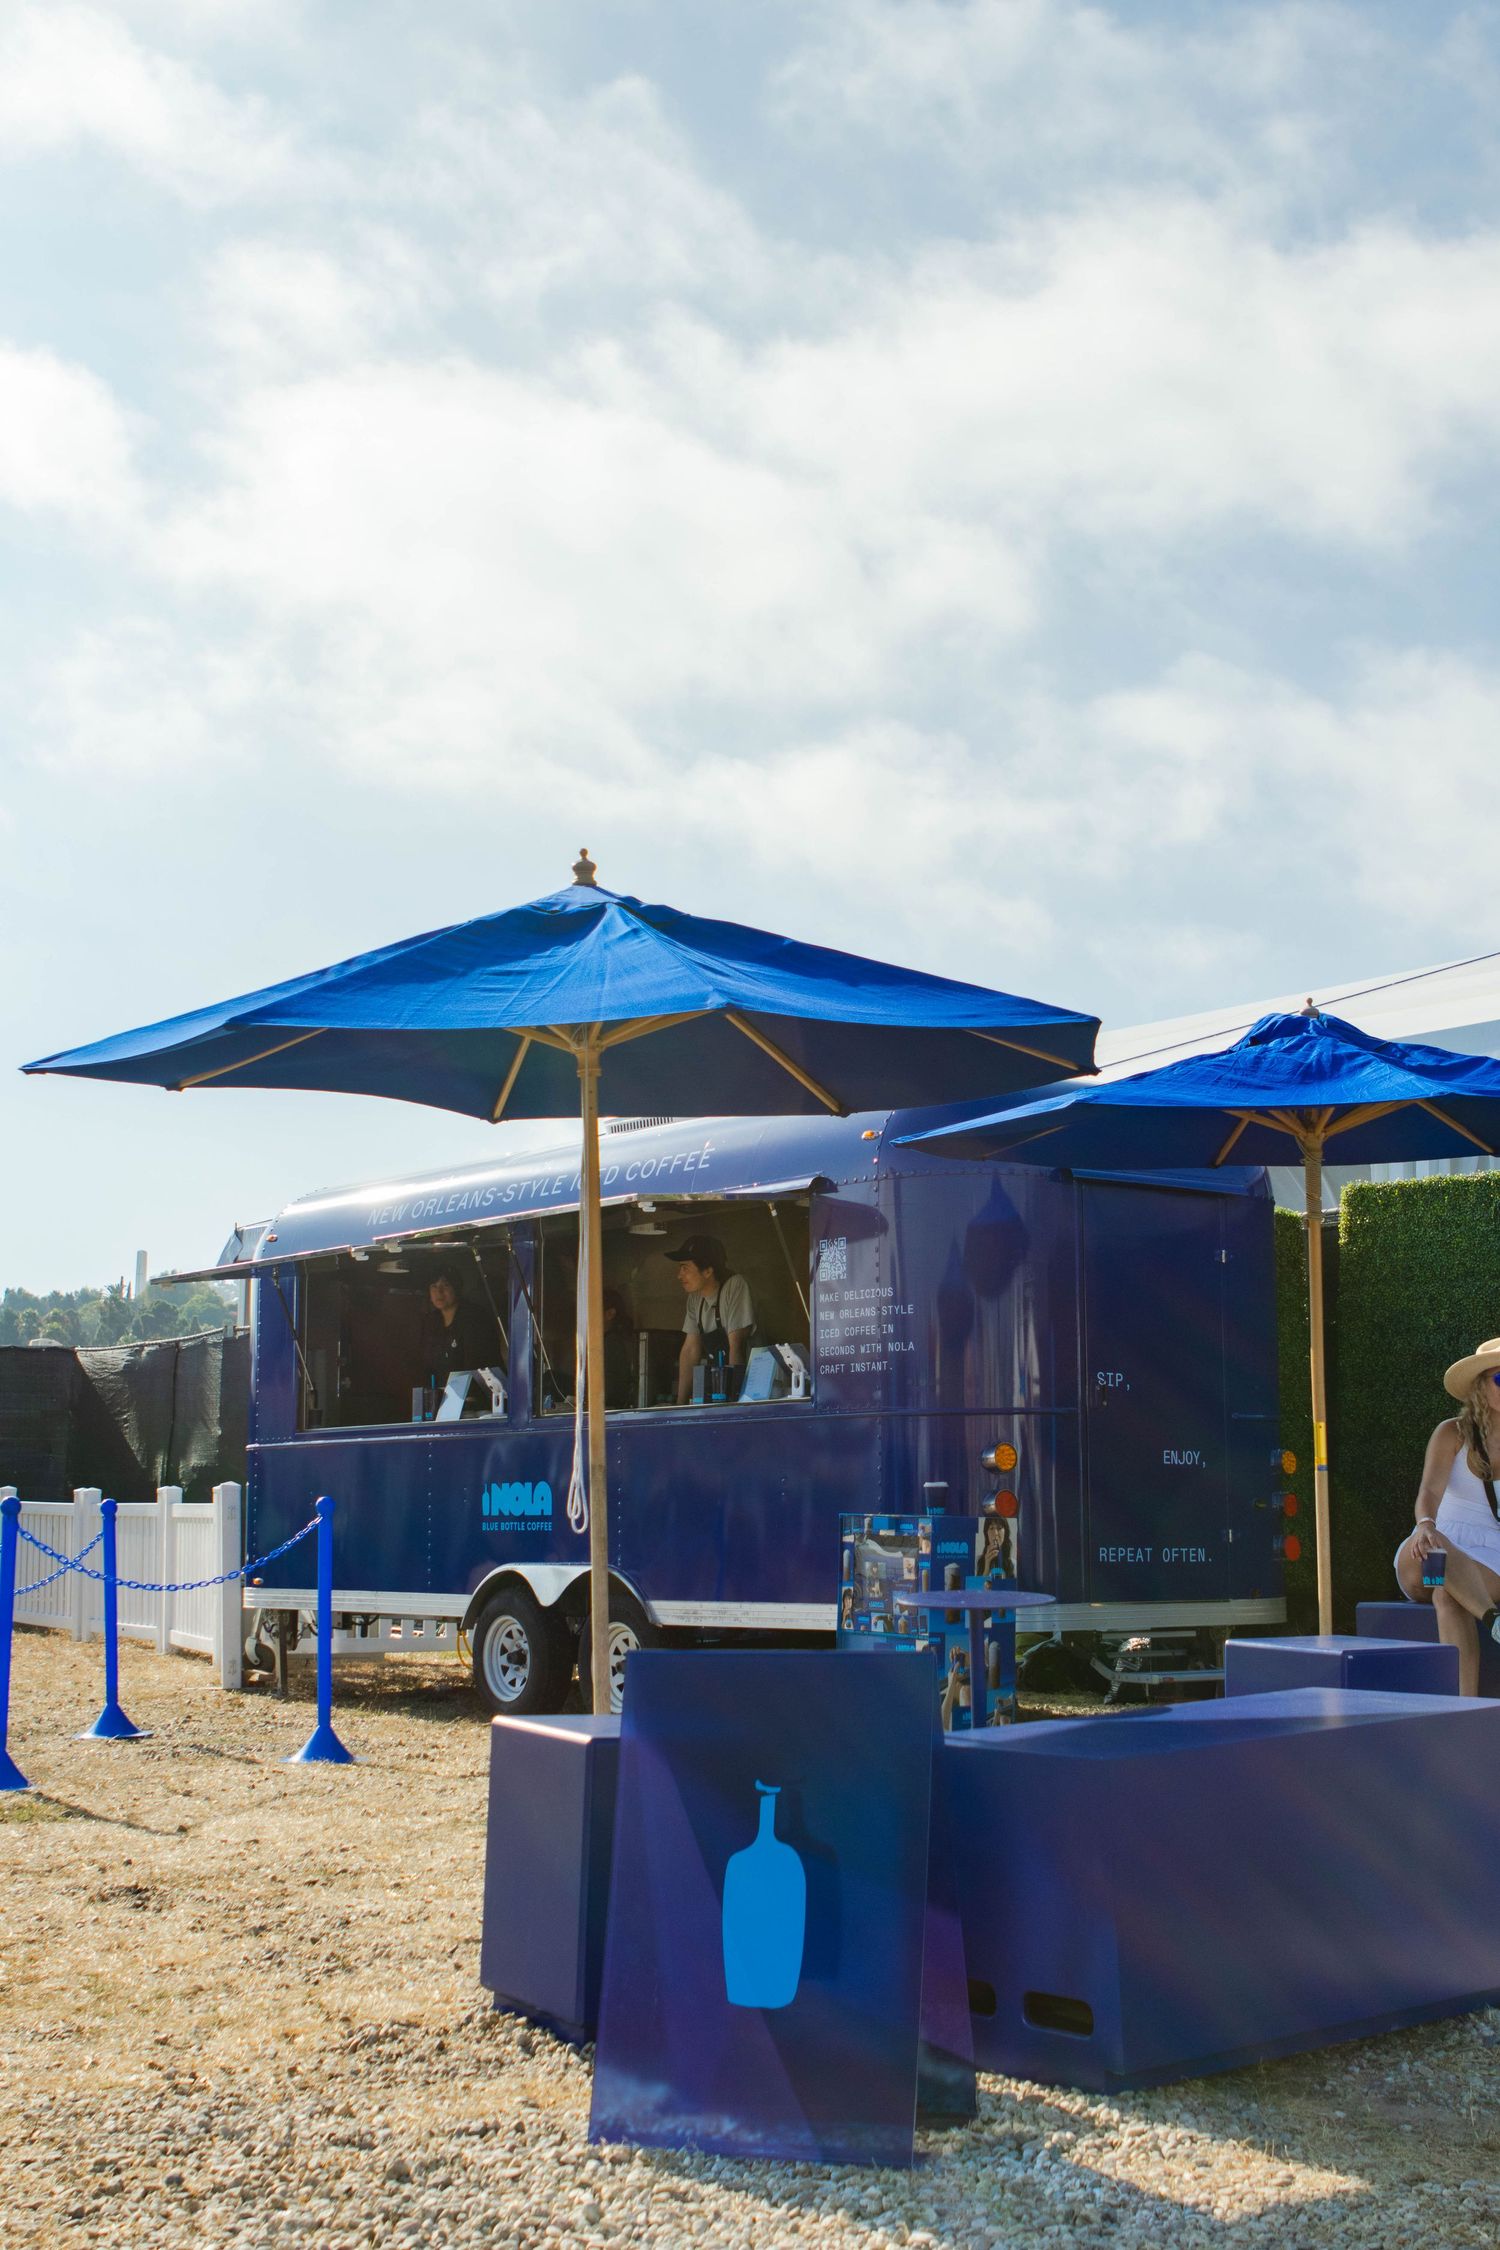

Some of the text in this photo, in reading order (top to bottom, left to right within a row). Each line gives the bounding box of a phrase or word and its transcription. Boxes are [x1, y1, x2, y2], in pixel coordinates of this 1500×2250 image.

[367, 1148, 716, 1227] NEW ORLEANS-STYLE ID COFFEE
[819, 1287, 894, 1303] MAKE DELICIOUS
[819, 1304, 914, 1321] NEW ORLEANS-STYLE
[819, 1323, 894, 1339] ICED COFFEE IN
[819, 1341, 915, 1357] SECONDS WITH NOLA
[819, 1360, 893, 1375] CRAFT INSTANT.
[1097, 1371, 1131, 1391] SIP,
[1163, 1450, 1207, 1468] ENJOY,
[490, 1481, 553, 1516] NOLA
[482, 1522, 552, 1531] BLUE BOTTLE COFFEE
[1100, 1548, 1213, 1563] REPEAT OFTEN.
